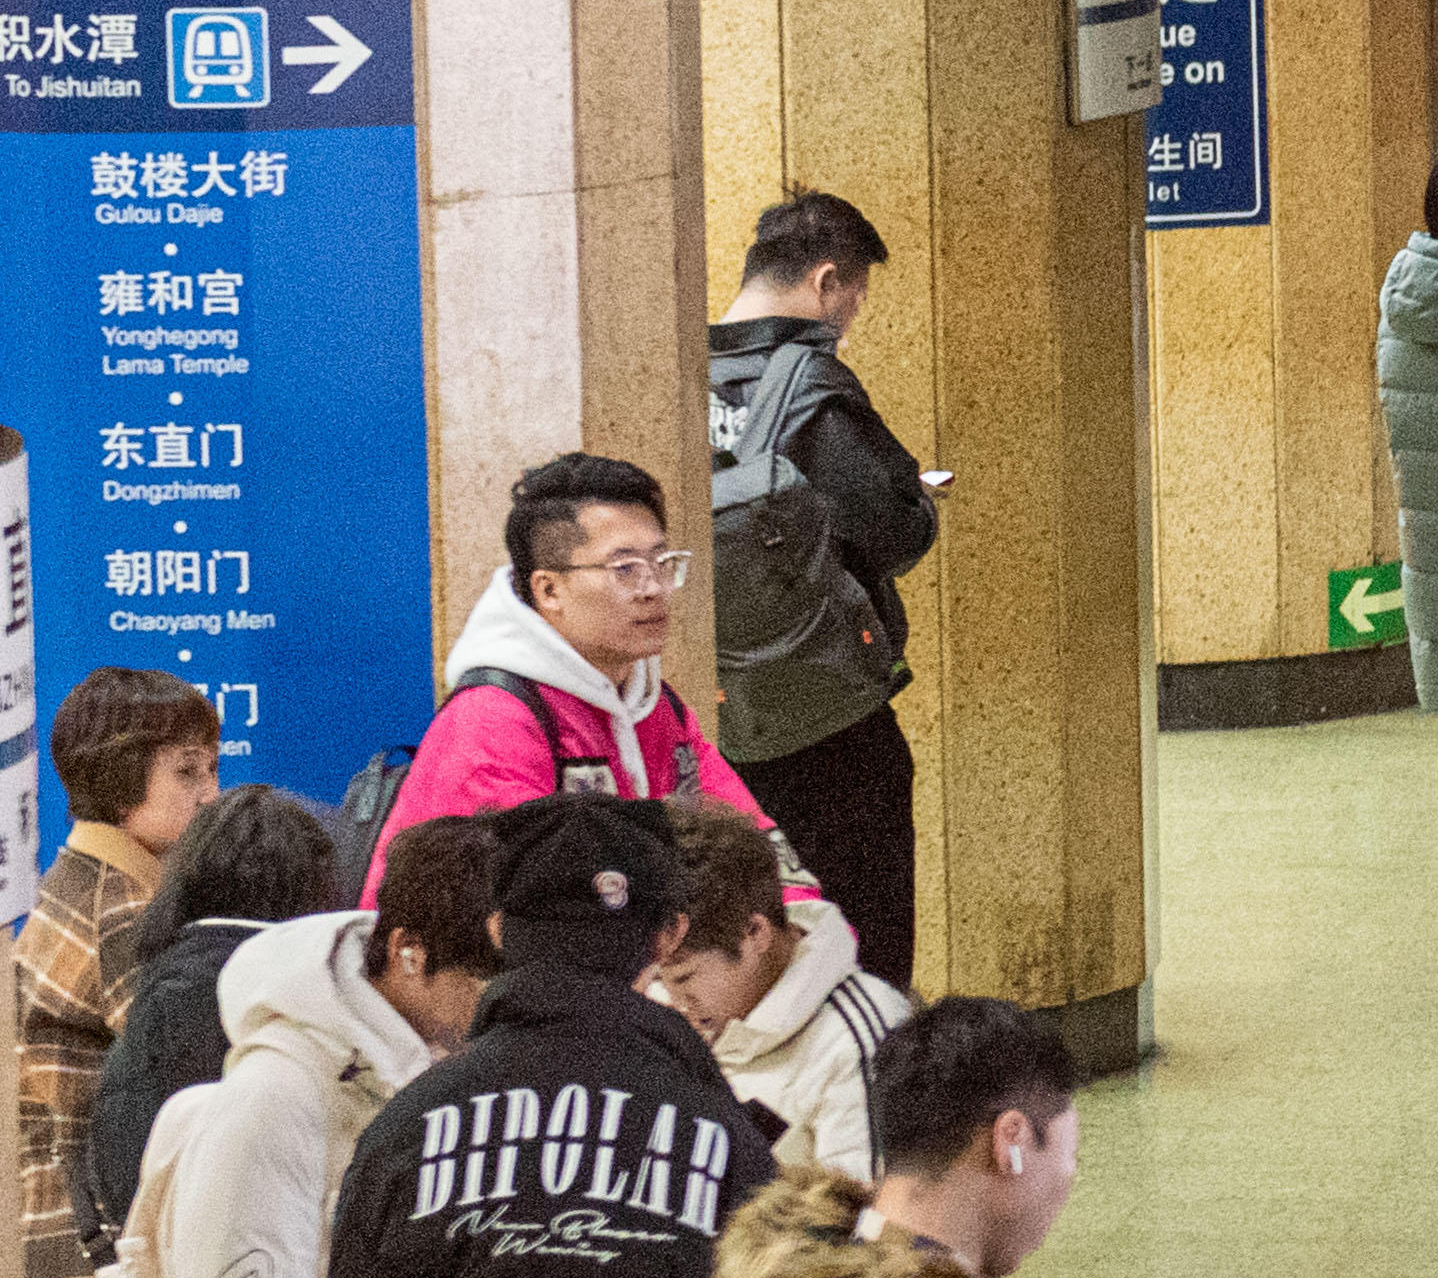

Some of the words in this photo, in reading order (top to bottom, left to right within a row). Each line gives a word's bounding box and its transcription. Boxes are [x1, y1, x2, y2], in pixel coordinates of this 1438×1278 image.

[0, 13, 139, 65] 积水潭
[5, 74, 31, 97] To
[35, 74, 142, 99] Jishuitan
[1185, 61, 1225, 84] on
[1148, 132, 1223, 173] 生间
[90, 149, 289, 198] 鼓楼大街
[95, 203, 159, 225] Gulou
[165, 203, 224, 227] Dajie
[98, 269, 244, 317] 雍和宫
[101, 326, 240, 351] Yonghegong
[103, 354, 166, 375] Lama
[170, 353, 250, 379] Temple
[101, 422, 244, 470] 东直门
[103, 480, 242, 505] Dongzhimen
[104, 549, 251, 596] 朝阳门
[109, 610, 222, 636] Chaoyang
[226, 610, 276, 631] Men
[409, 1083, 731, 1238] BIPOLAR
